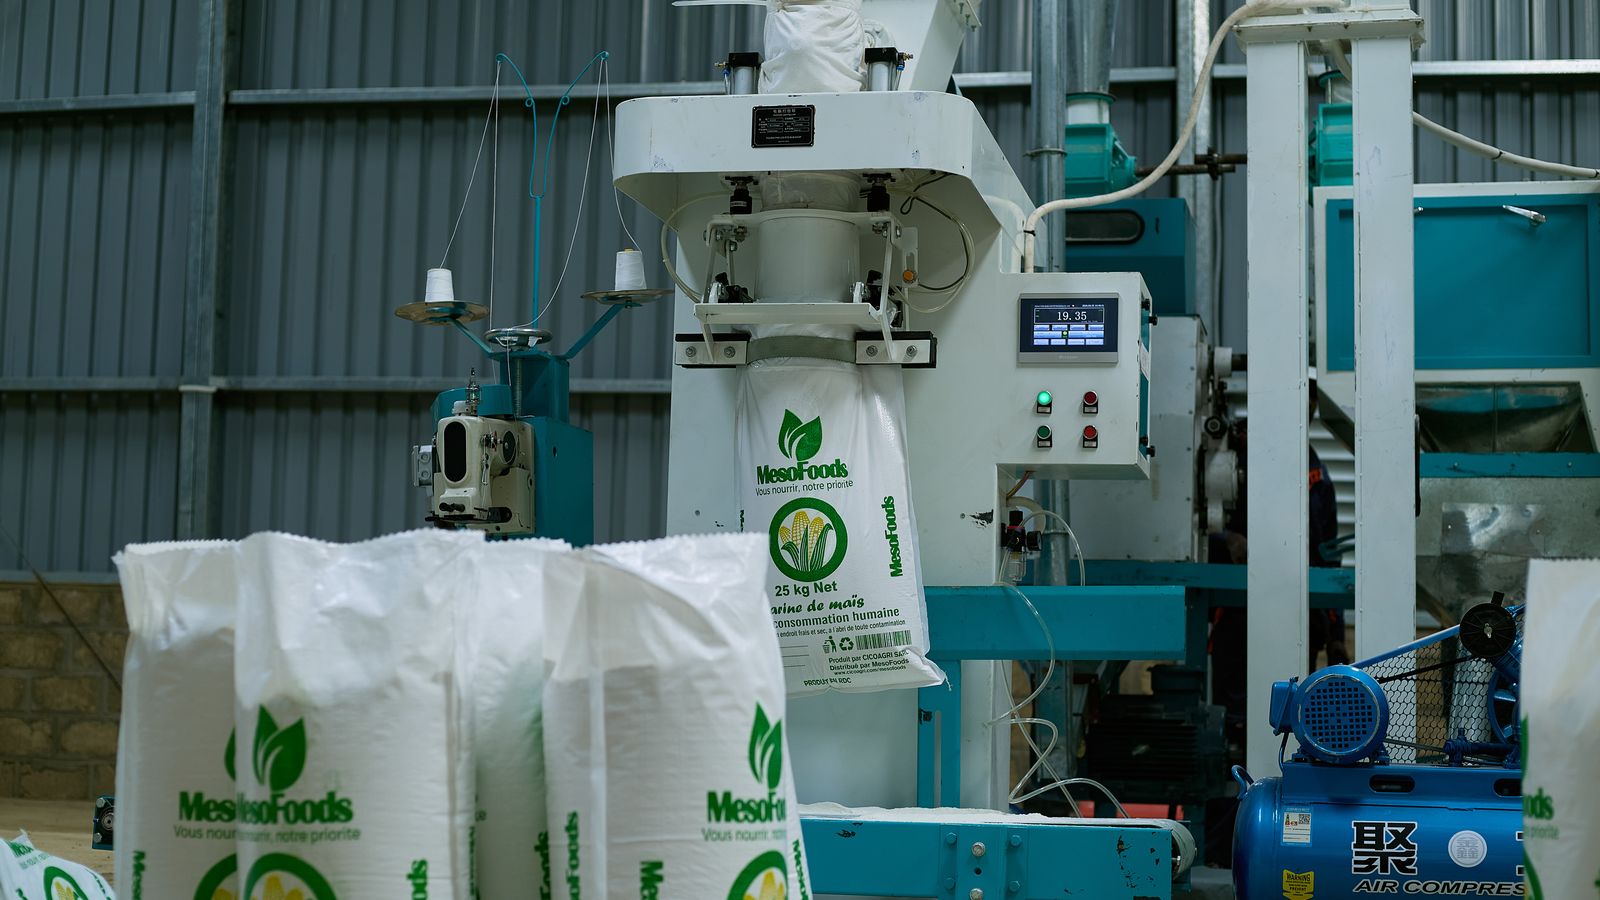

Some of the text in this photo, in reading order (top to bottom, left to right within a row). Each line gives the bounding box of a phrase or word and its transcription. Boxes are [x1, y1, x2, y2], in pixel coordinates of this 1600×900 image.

[1057, 311, 1087, 321] 19.35
[757, 458, 848, 485] MesoFoods
[755, 486, 771, 497] Vous
[772, 483, 800, 495] nourrir,
[802, 480, 825, 492] notre
[881, 495, 903, 578] MesoFoods
[775, 580, 838, 598] 25 kg Net
[770, 594, 865, 615] arine de maïs
[852, 607, 900, 621] humaine
[854, 623, 869, 631] toute
[828, 655, 851, 664] Produit
[862, 651, 893, 661] CICOAGRI
[871, 657, 910, 667] MesoFoods
[179, 791, 236, 823] Mes
[1352, 821, 1417, 875] 聚
[640, 861, 663, 900] Me
[1353, 879, 1525, 897] AIR COMPRES
